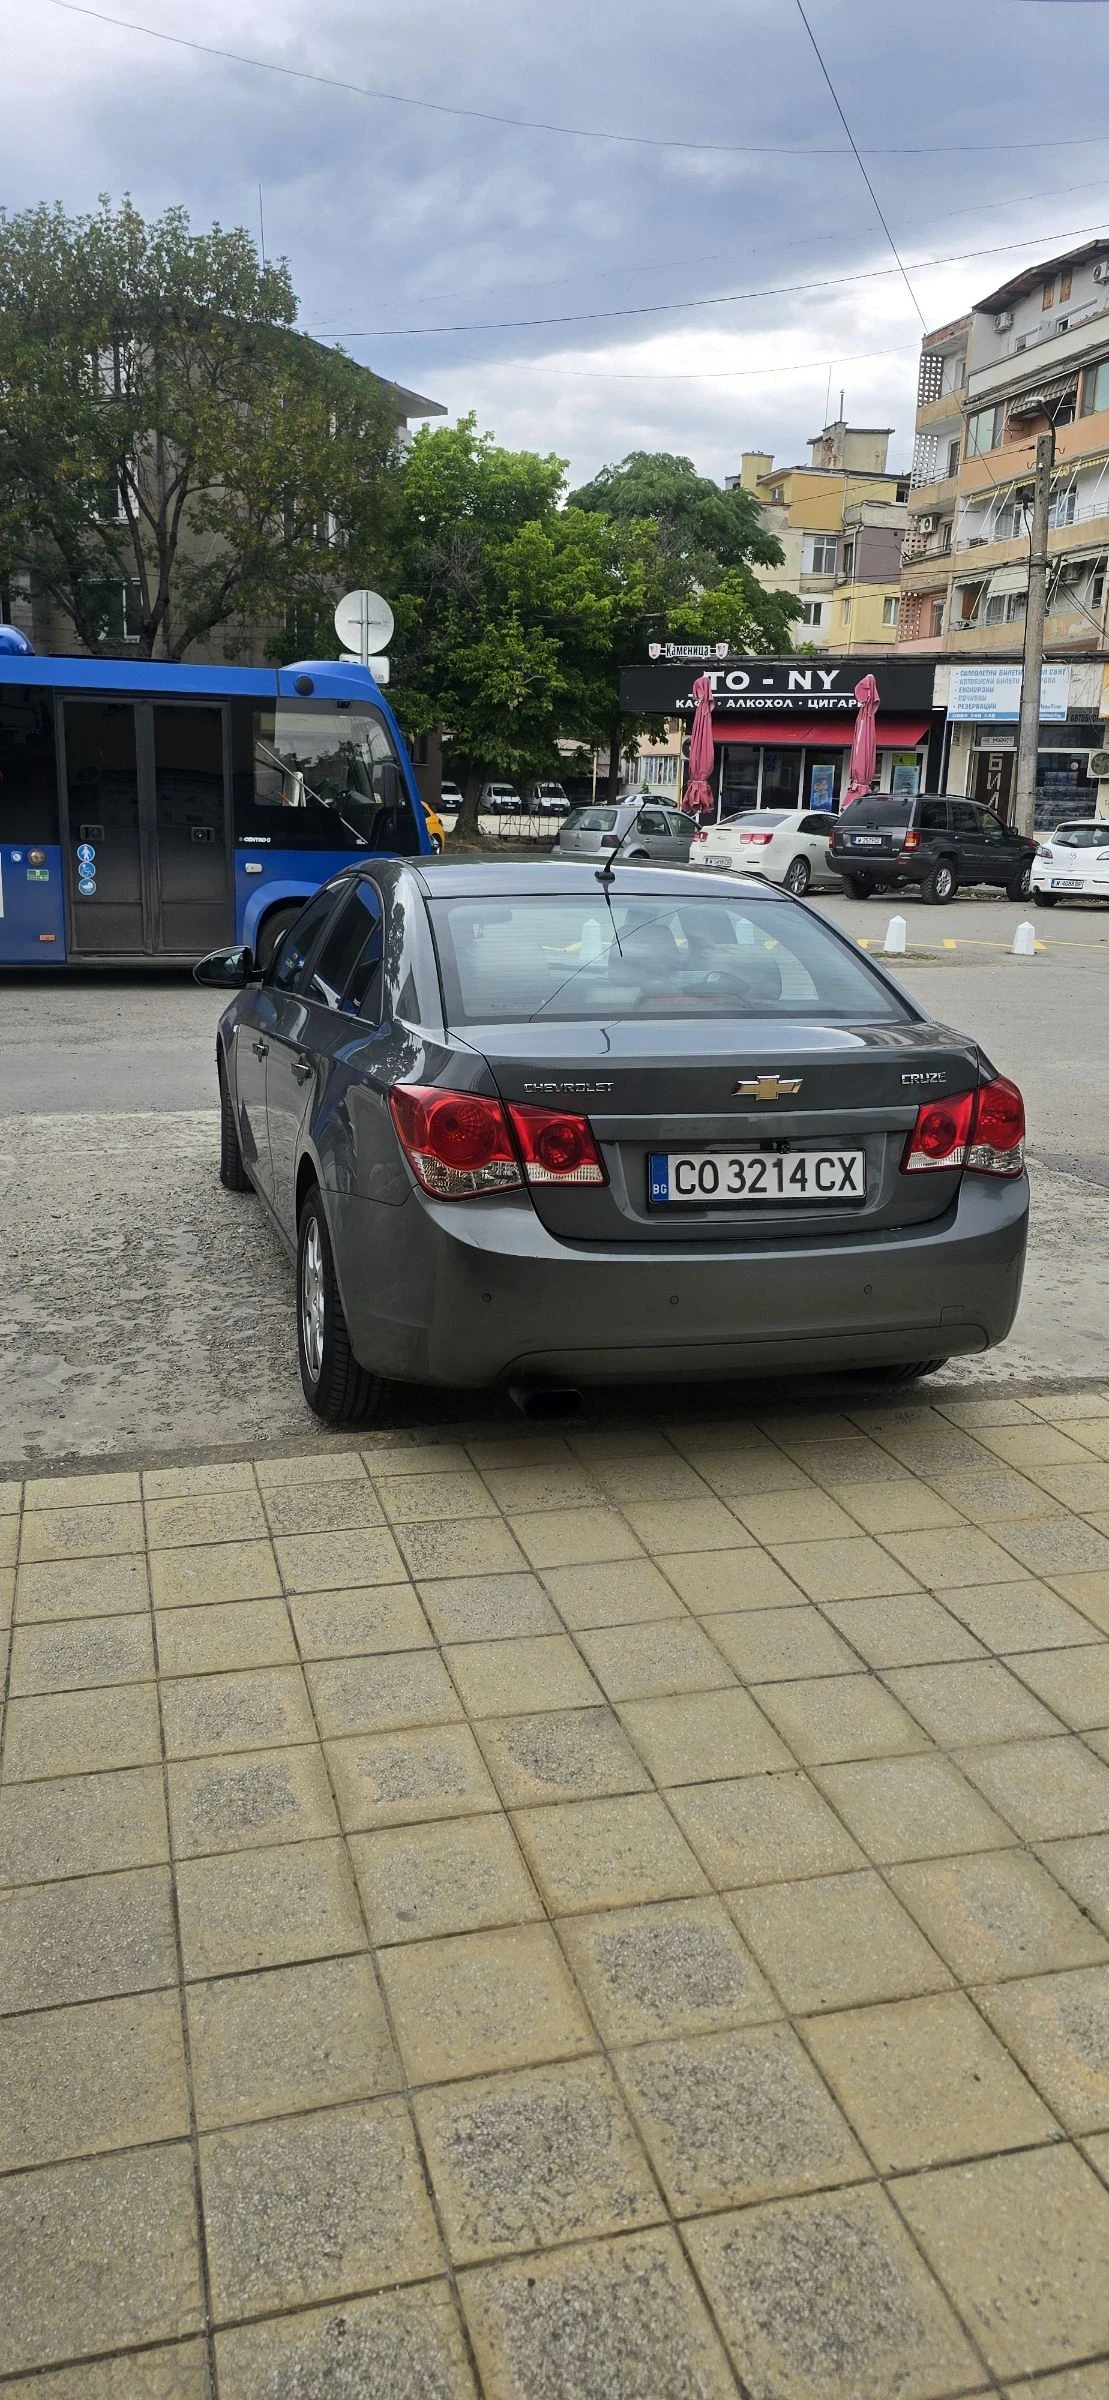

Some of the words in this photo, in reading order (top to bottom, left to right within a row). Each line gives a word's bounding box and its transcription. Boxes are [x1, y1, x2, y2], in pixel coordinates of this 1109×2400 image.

[666, 643, 709, 658] Каменица
[1049, 668, 1066, 676] СВЯТ
[703, 670, 750, 691] TO
[787, 670, 840, 690] NY
[726, 698, 793, 708] АЛКОХОЛ
[901, 1071, 947, 1085] CRUZE
[523, 1082, 614, 1093] CHEVROLET
[675, 1159, 719, 1194] CO
[727, 1156, 807, 1193] 3214
[815, 1156, 857, 1191] CX
[653, 1184, 667, 1195] BG
